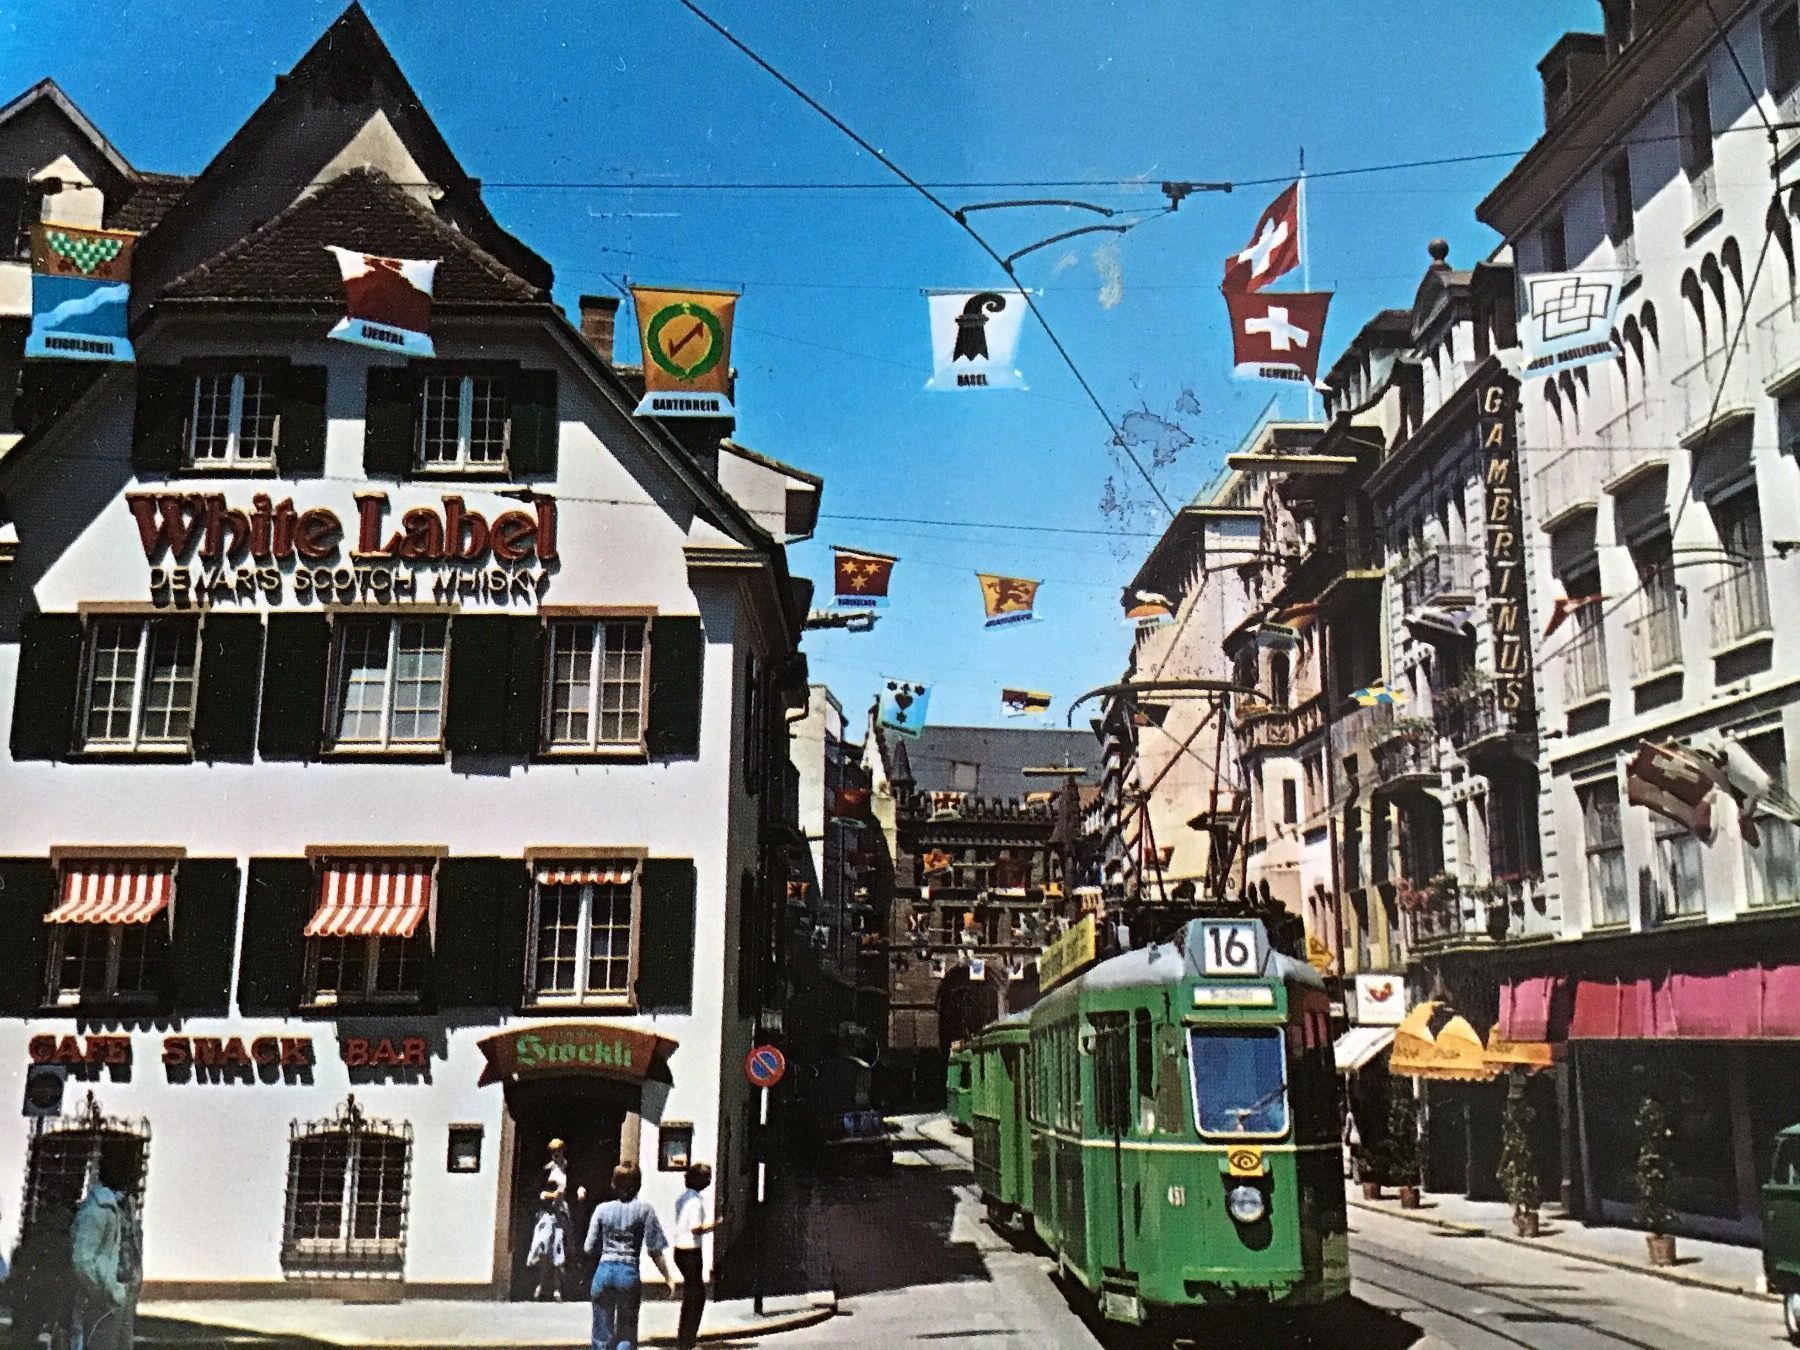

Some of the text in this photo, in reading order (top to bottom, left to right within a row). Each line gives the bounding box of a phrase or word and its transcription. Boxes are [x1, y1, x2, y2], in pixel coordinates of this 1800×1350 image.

[957, 374, 989, 387] BASEL
[125, 490, 558, 560] White Label
[1484, 386, 1522, 709] GAMBRINUS
[294, 565, 413, 590] SCOTCH
[432, 566, 548, 591] WHISKY
[1208, 926, 1249, 967] 16
[161, 1035, 315, 1065] SNACK
[344, 1037, 429, 1067] BAR
